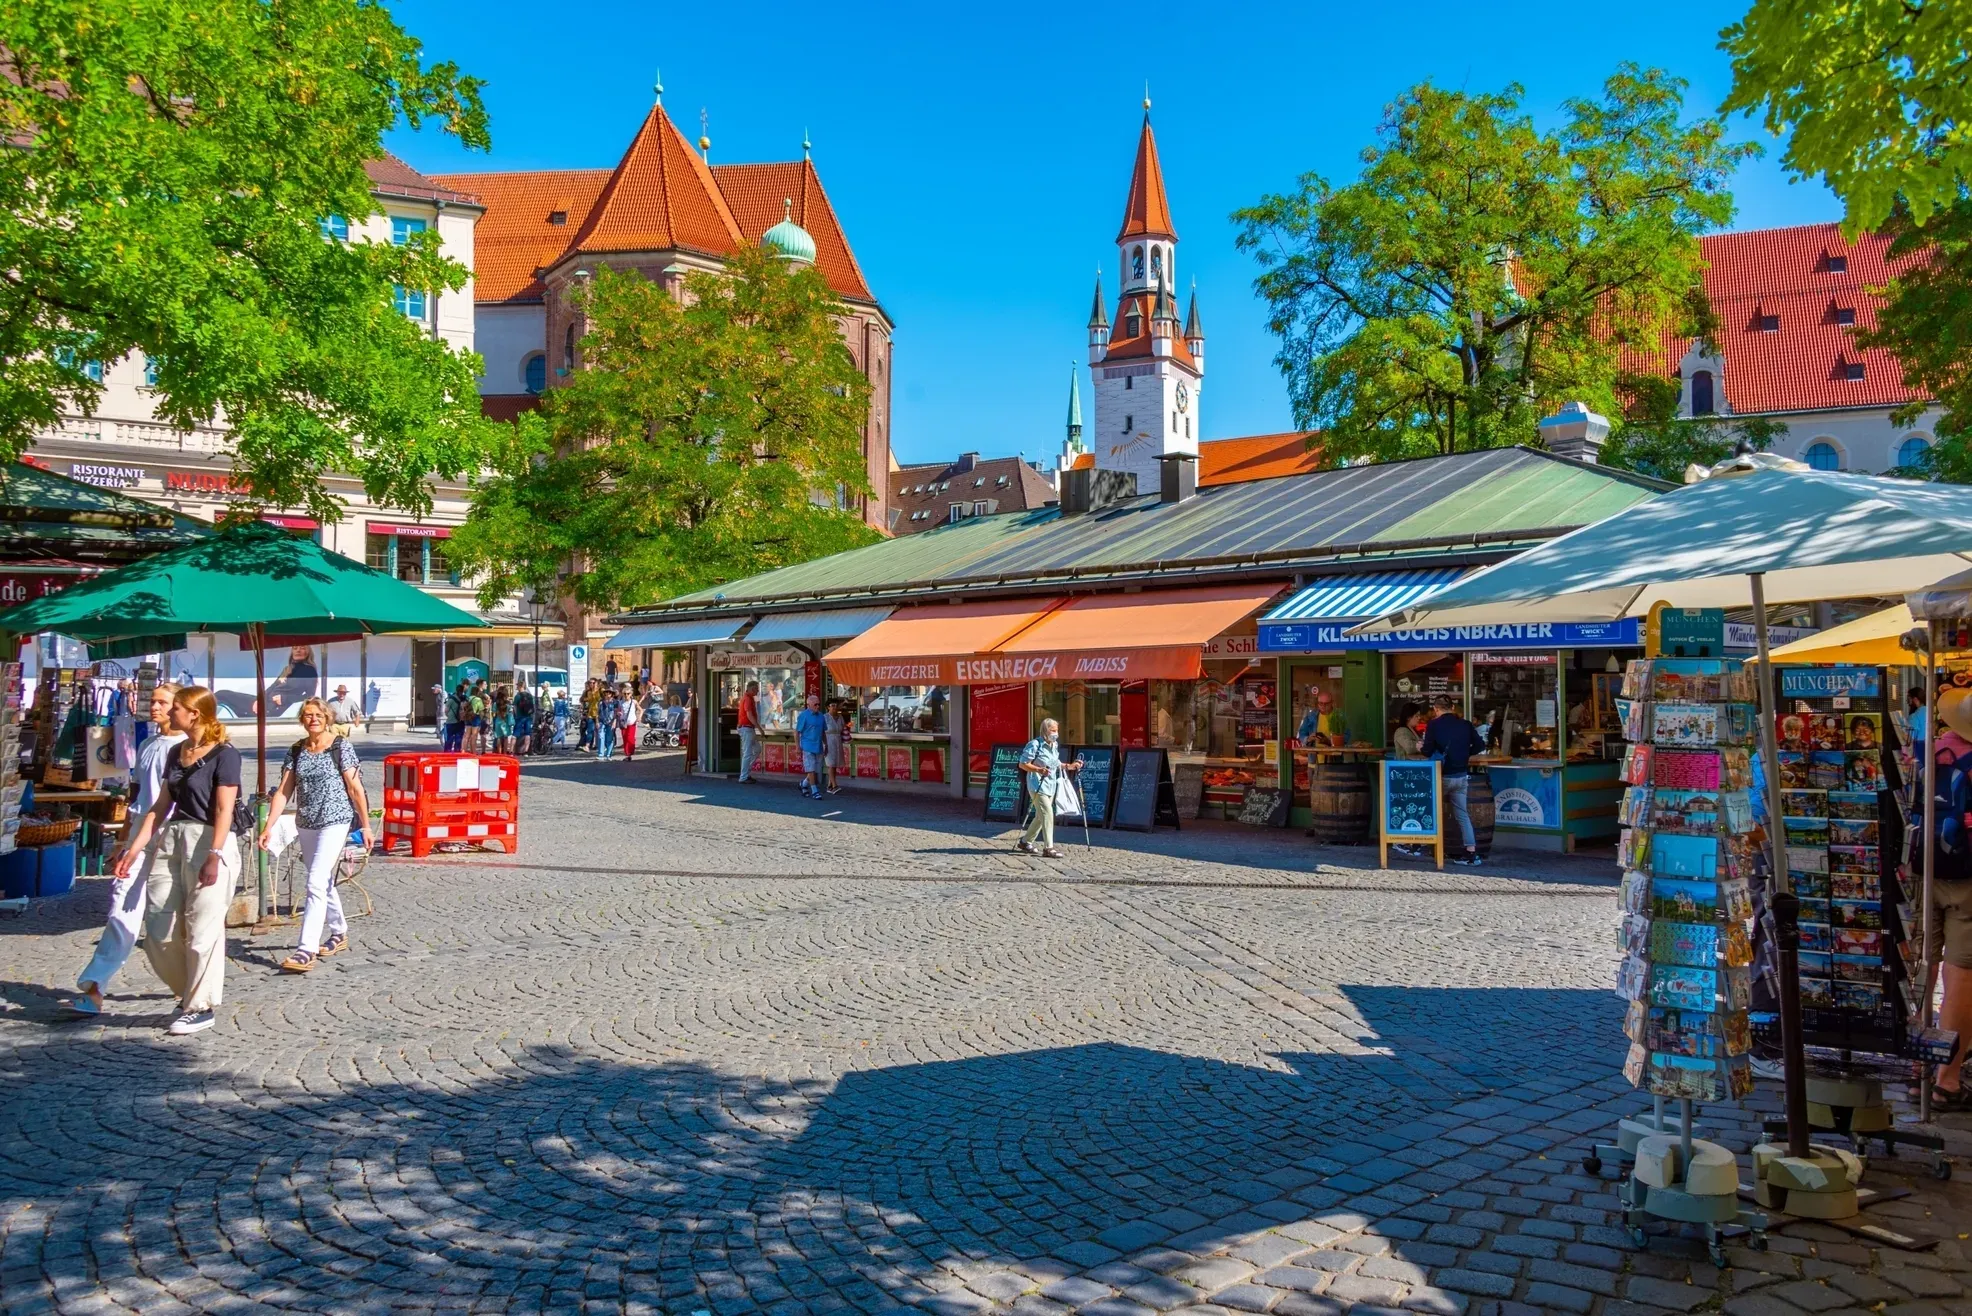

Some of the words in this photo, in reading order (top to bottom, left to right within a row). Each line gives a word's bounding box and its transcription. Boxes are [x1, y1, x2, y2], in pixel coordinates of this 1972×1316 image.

[72, 464, 146, 478] RISTORANTE
[396, 527, 437, 536] RISTORANTE
[870, 664, 940, 680] METZGEREI
[956, 657, 1057, 680] EISENREICH
[1074, 656, 1129, 673] IMBISS
[1786, 672, 1854, 691] MÜNCHEN
